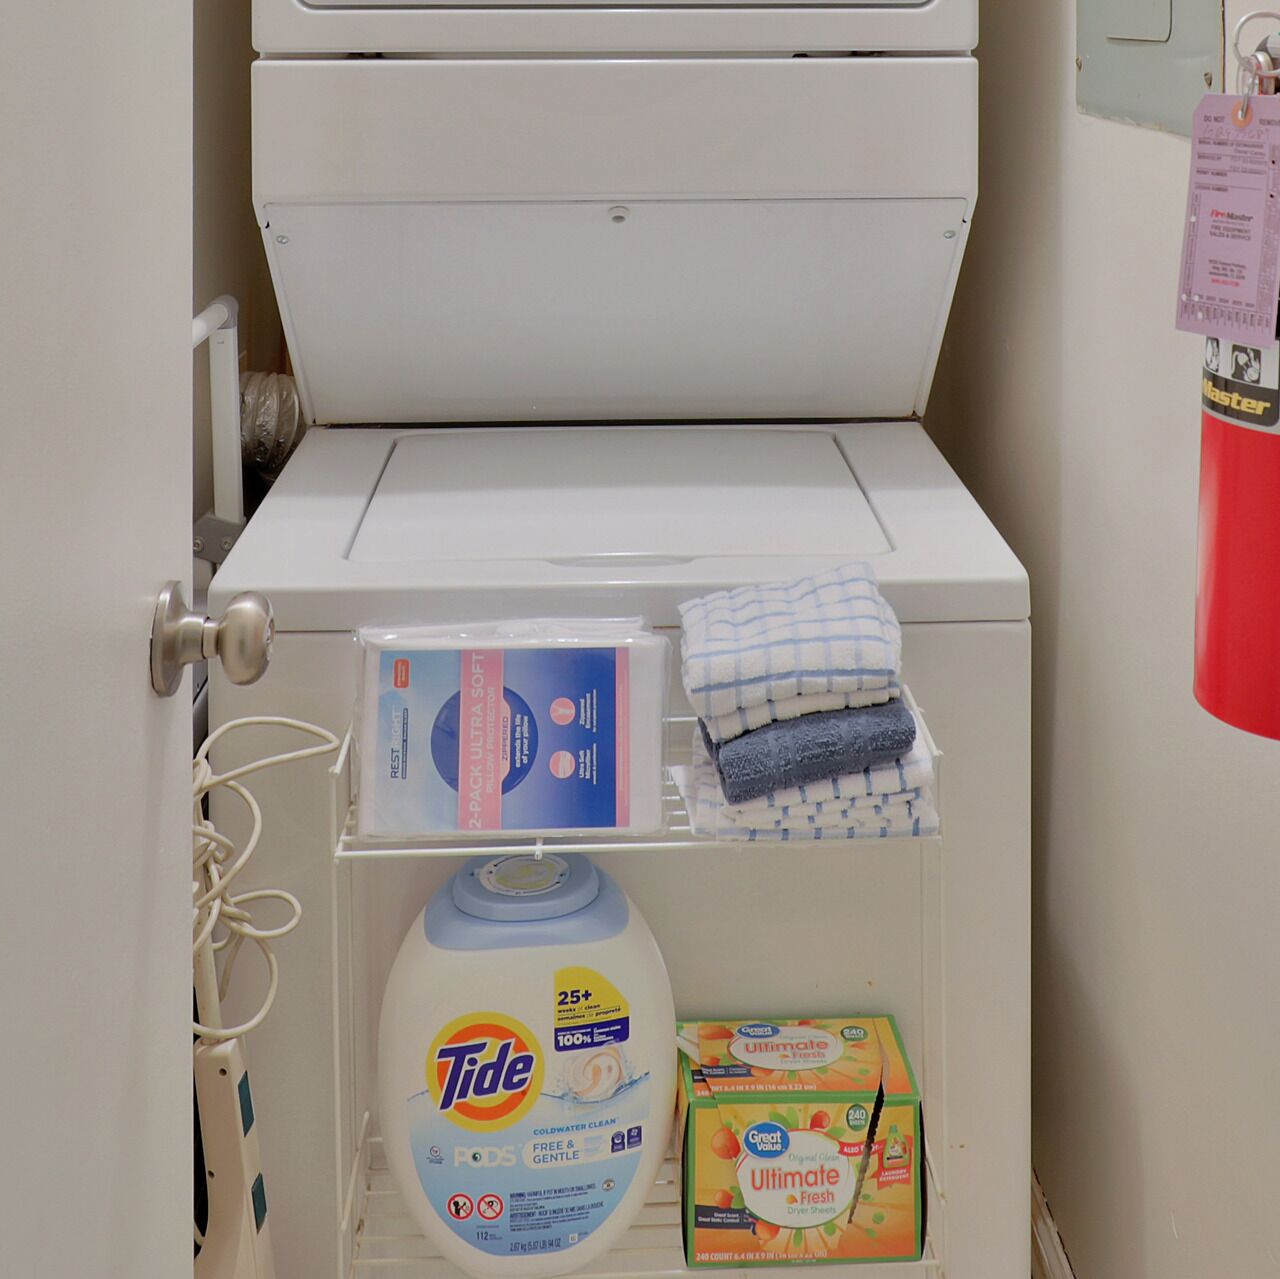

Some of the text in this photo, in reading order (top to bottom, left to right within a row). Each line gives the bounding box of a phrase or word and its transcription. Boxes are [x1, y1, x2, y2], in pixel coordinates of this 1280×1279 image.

[1213, 115, 1224, 123] NOT
[1222, 225, 1251, 233] EQUIPMENT
[514, 714, 522, 725] life
[522, 716, 530, 736] pillow
[469, 652, 485, 829] 2-PACK ULTRA SOFT
[486, 687, 496, 793] PILLOW PROTECTOR
[514, 740, 522, 768] extends
[522, 756, 529, 764] of
[558, 989, 592, 1006] 25+
[741, 1026, 772, 1034] Great
[843, 1028, 864, 1036] 240
[558, 1034, 592, 1047] 100%
[745, 1039, 829, 1054] Ultimate
[437, 1038, 534, 1111] Tide
[848, 1110, 866, 1119] 240
[533, 1119, 616, 1136] COLDWATER CLEAN
[749, 1130, 782, 1143] Great
[533, 1139, 575, 1152] FREE &
[757, 1142, 782, 1151] Value
[454, 1144, 516, 1168] PODS
[533, 1151, 580, 1164] GENTLE
[751, 1165, 840, 1192] Ultimate
[800, 1190, 834, 1204] Fresh
[787, 1206, 836, 1216] Dryer Sheets
[477, 1232, 488, 1240] 112
[710, 1252, 733, 1260] COUNT
